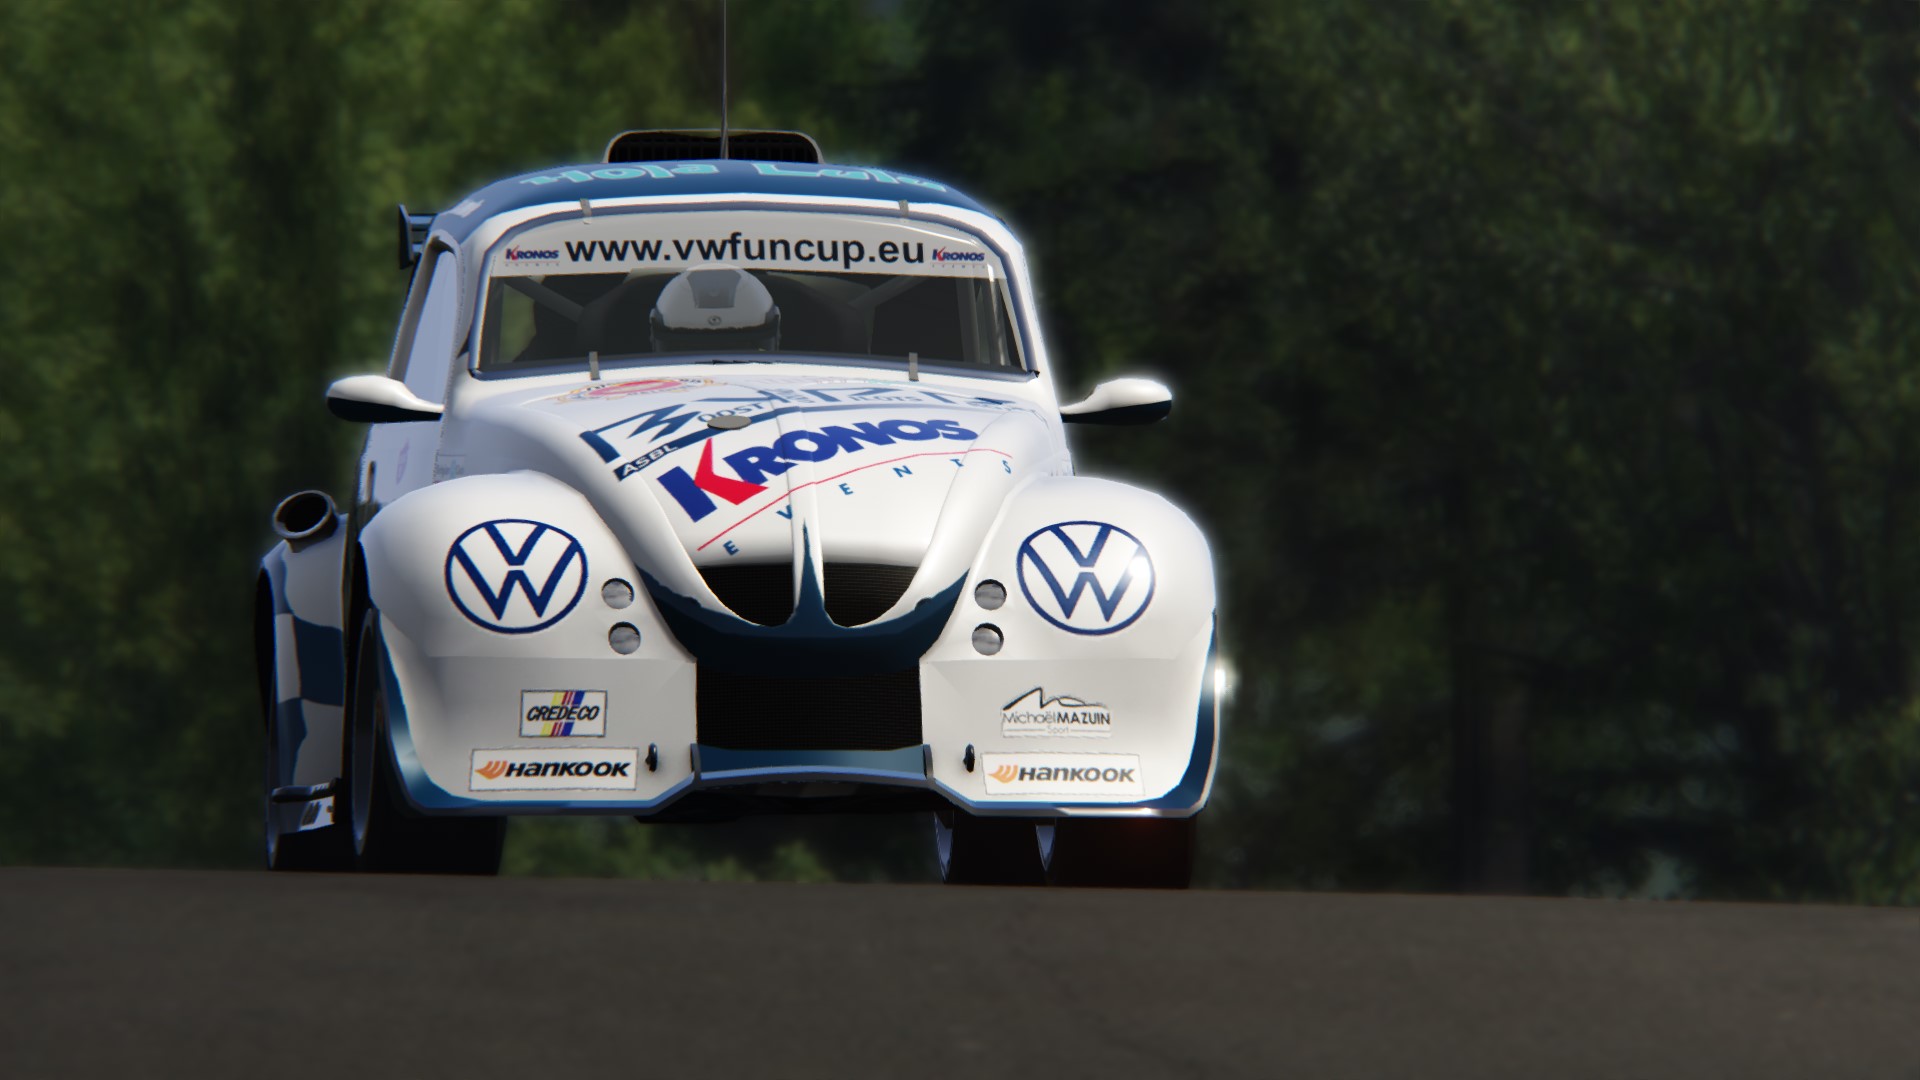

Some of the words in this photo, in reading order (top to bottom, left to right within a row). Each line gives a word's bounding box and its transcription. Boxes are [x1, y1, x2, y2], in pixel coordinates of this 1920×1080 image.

[505, 245, 560, 261] KRONOS
[564, 232, 925, 269] www.vwfuncup.eu
[931, 246, 985, 262] KRONOS
[621, 443, 679, 478] ASBL
[656, 419, 979, 523] KRONOS
[526, 704, 601, 722] CREDECO
